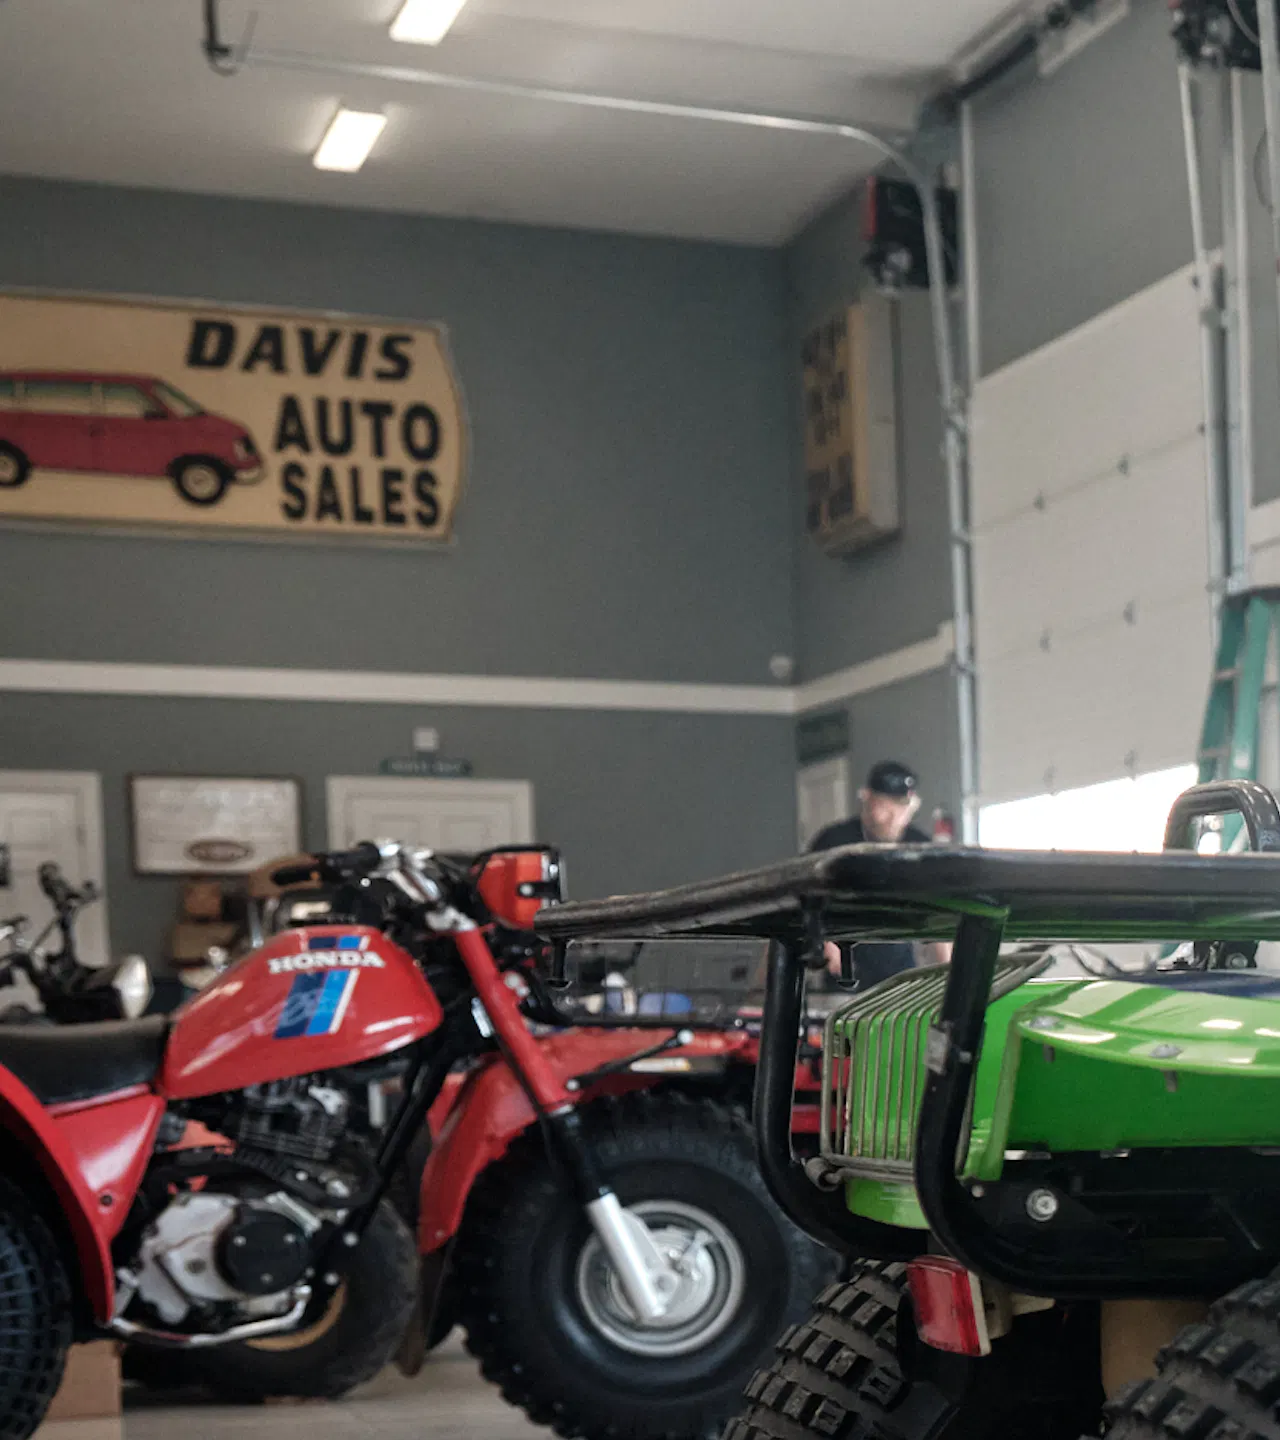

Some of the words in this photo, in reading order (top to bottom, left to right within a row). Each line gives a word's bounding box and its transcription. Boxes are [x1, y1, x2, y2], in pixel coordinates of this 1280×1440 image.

[187, 318, 417, 381] DAVIS
[274, 393, 442, 462] AUTO
[280, 462, 441, 528] SALES
[267, 950, 386, 974] HONDA
